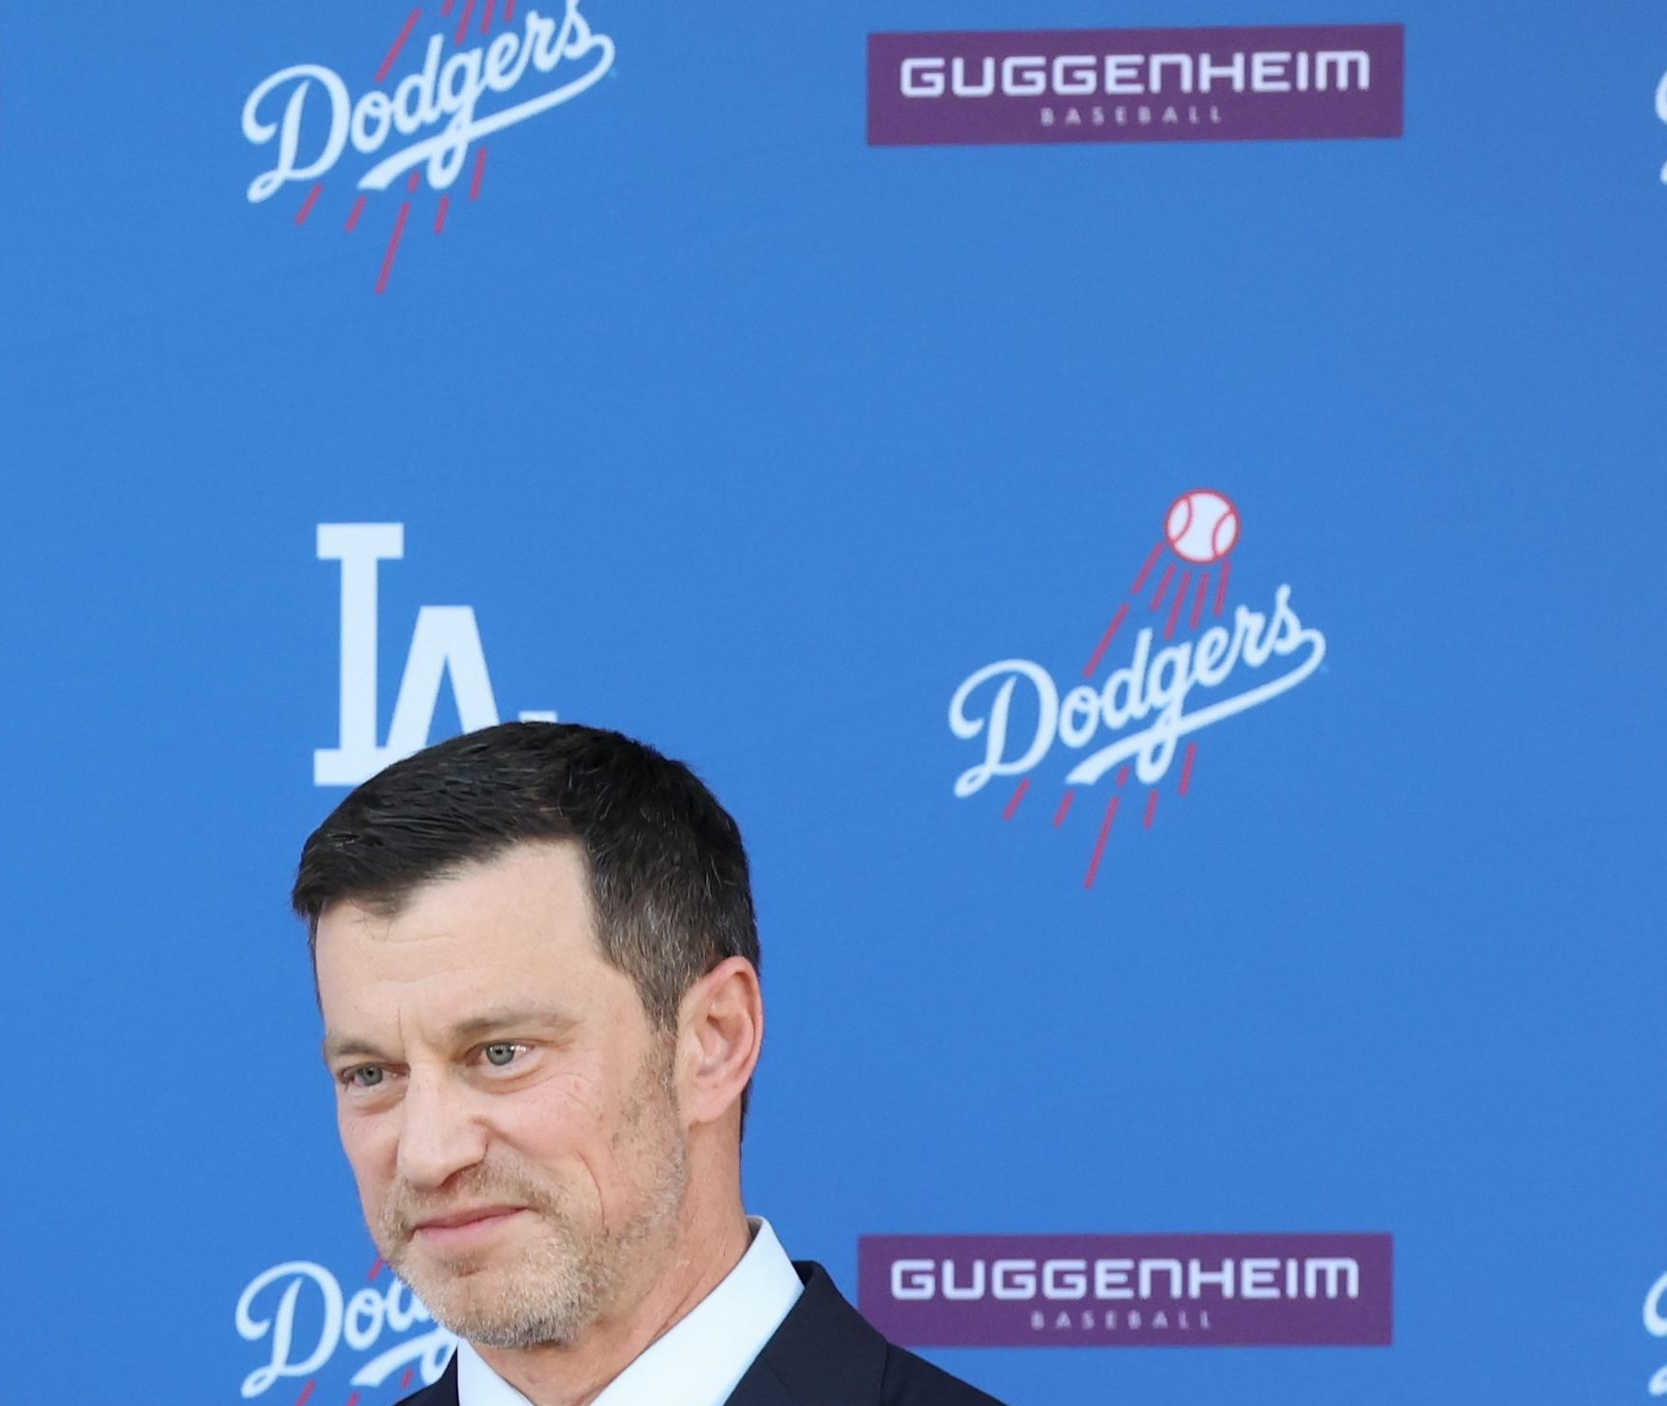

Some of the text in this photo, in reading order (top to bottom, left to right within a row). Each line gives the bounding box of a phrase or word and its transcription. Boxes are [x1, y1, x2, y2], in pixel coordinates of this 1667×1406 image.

[899, 49, 1371, 99] GUGGENHEIM
[241, 0, 616, 203] Dodgers
[1039, 104, 1223, 127] BASEBALL
[948, 584, 1327, 798] Dodgers
[890, 1257, 1360, 1301] GUGGENHEIM
[1030, 1309, 1213, 1331] BASEBALL
